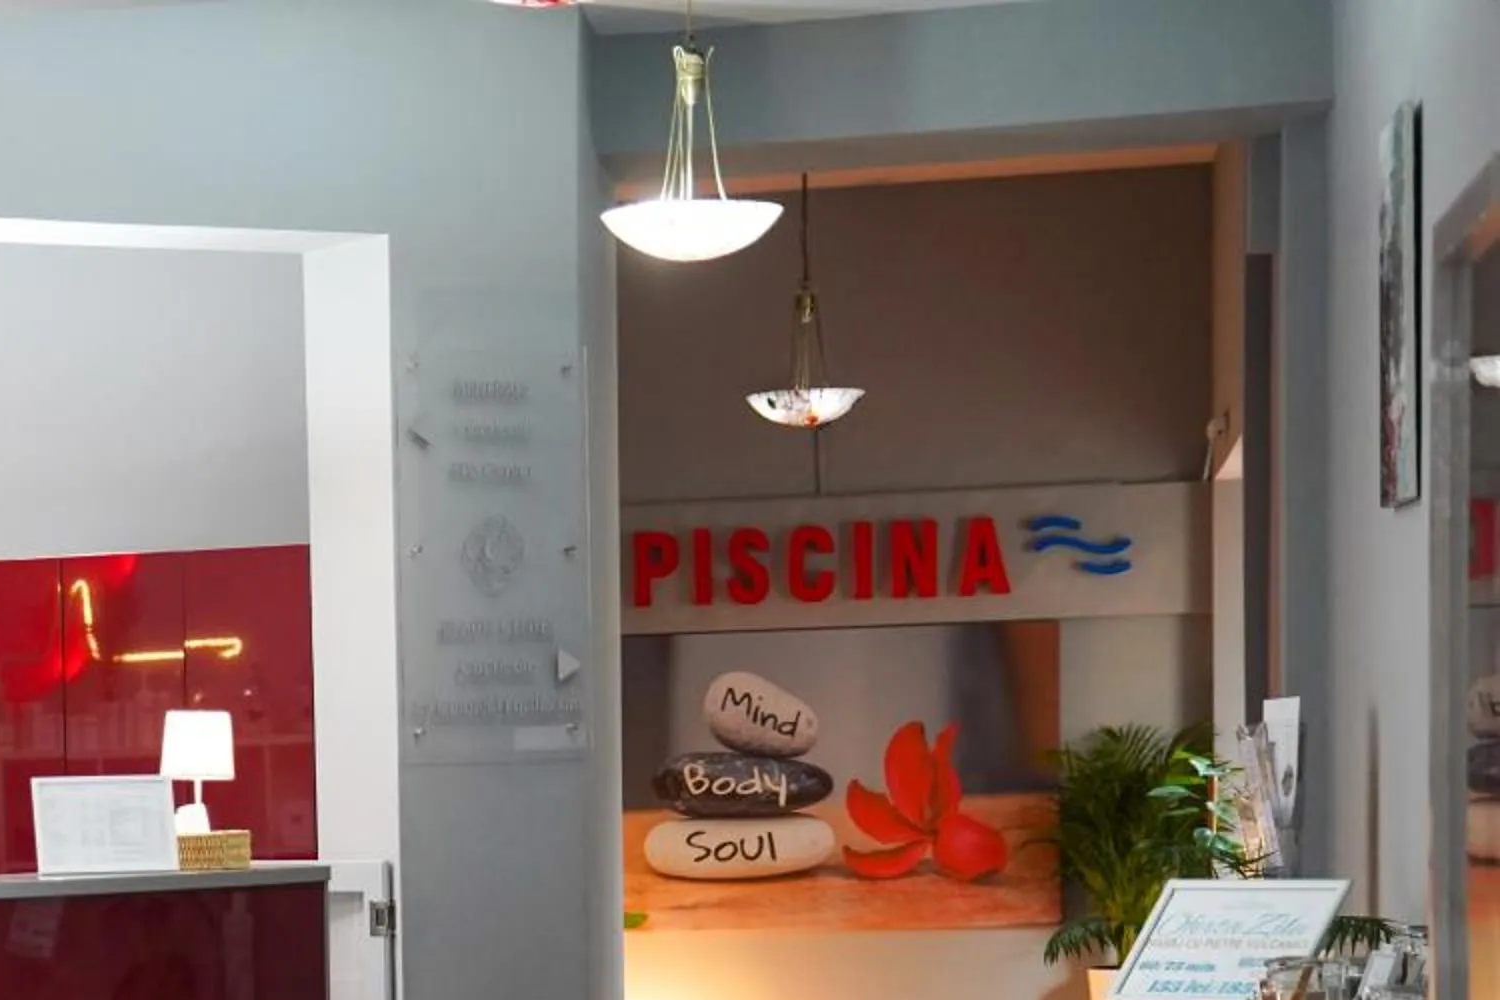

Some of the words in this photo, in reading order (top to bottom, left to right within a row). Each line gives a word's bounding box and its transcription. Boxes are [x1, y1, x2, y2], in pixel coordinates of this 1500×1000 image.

[631, 514, 1012, 609] PISCINA
[720, 687, 802, 738] Mind
[683, 762, 788, 808] Body
[685, 831, 777, 863] Soul
